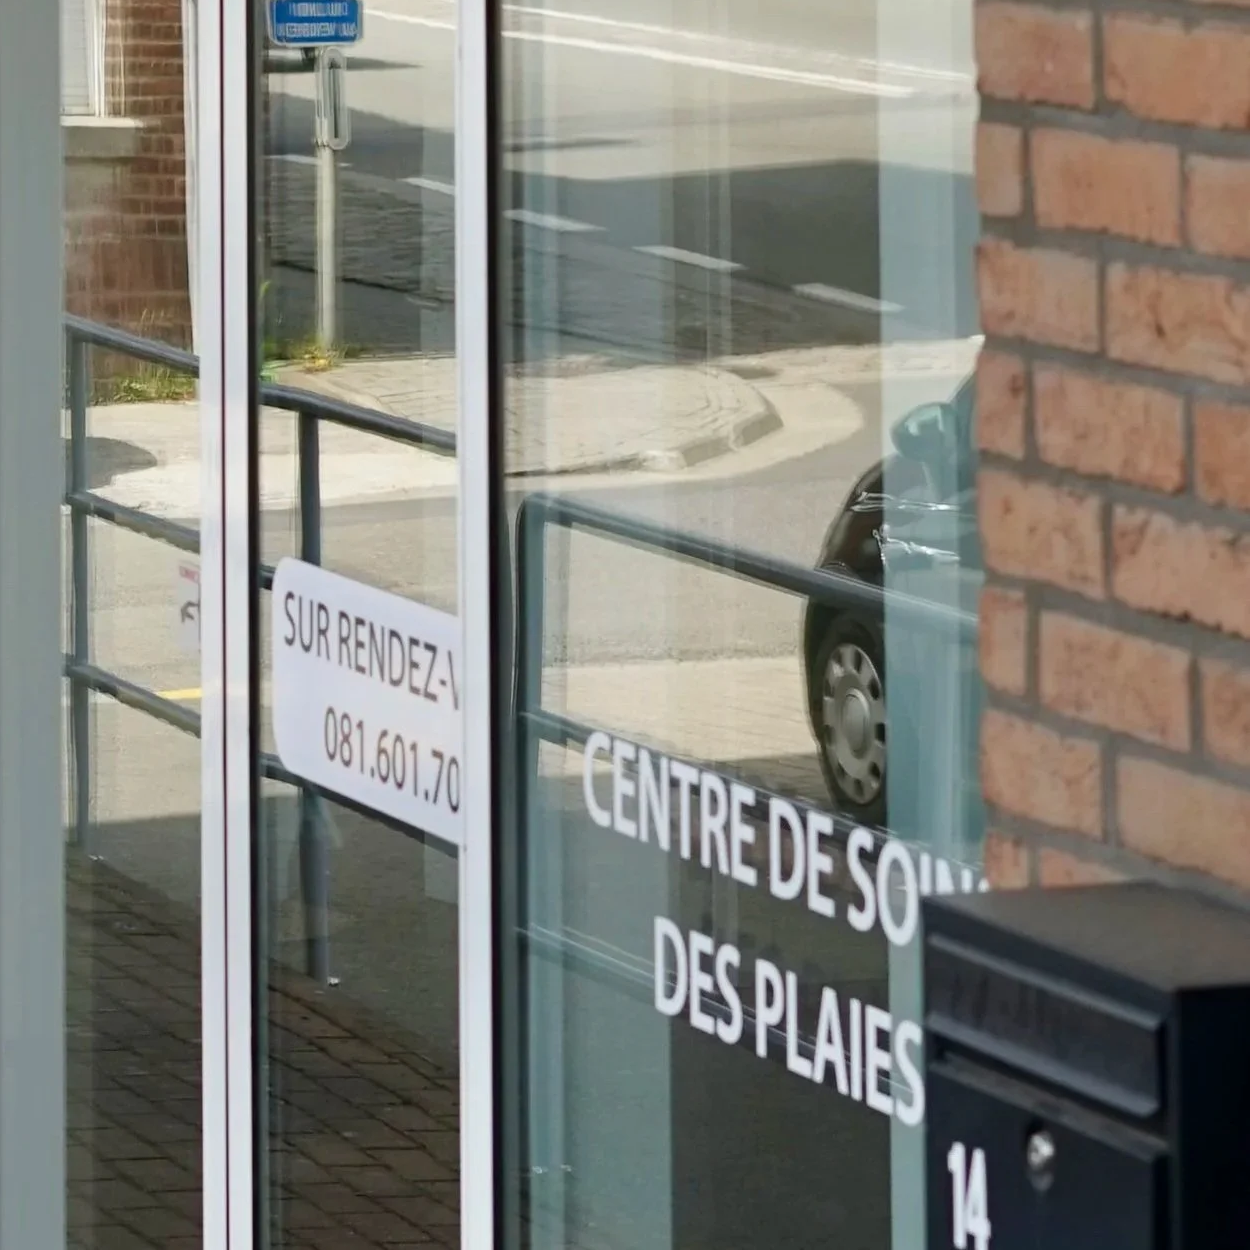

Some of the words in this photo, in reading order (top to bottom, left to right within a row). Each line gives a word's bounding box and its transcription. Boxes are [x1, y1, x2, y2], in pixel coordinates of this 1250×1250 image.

[284, 590, 331, 662] SUR
[324, 706, 460, 813] 081.601.70
[582, 730, 757, 887] CENTRE
[769, 795, 836, 919] DE
[654, 915, 744, 1045] DES
[755, 957, 925, 1127] PLAIES
[947, 1141, 992, 1250] 14
